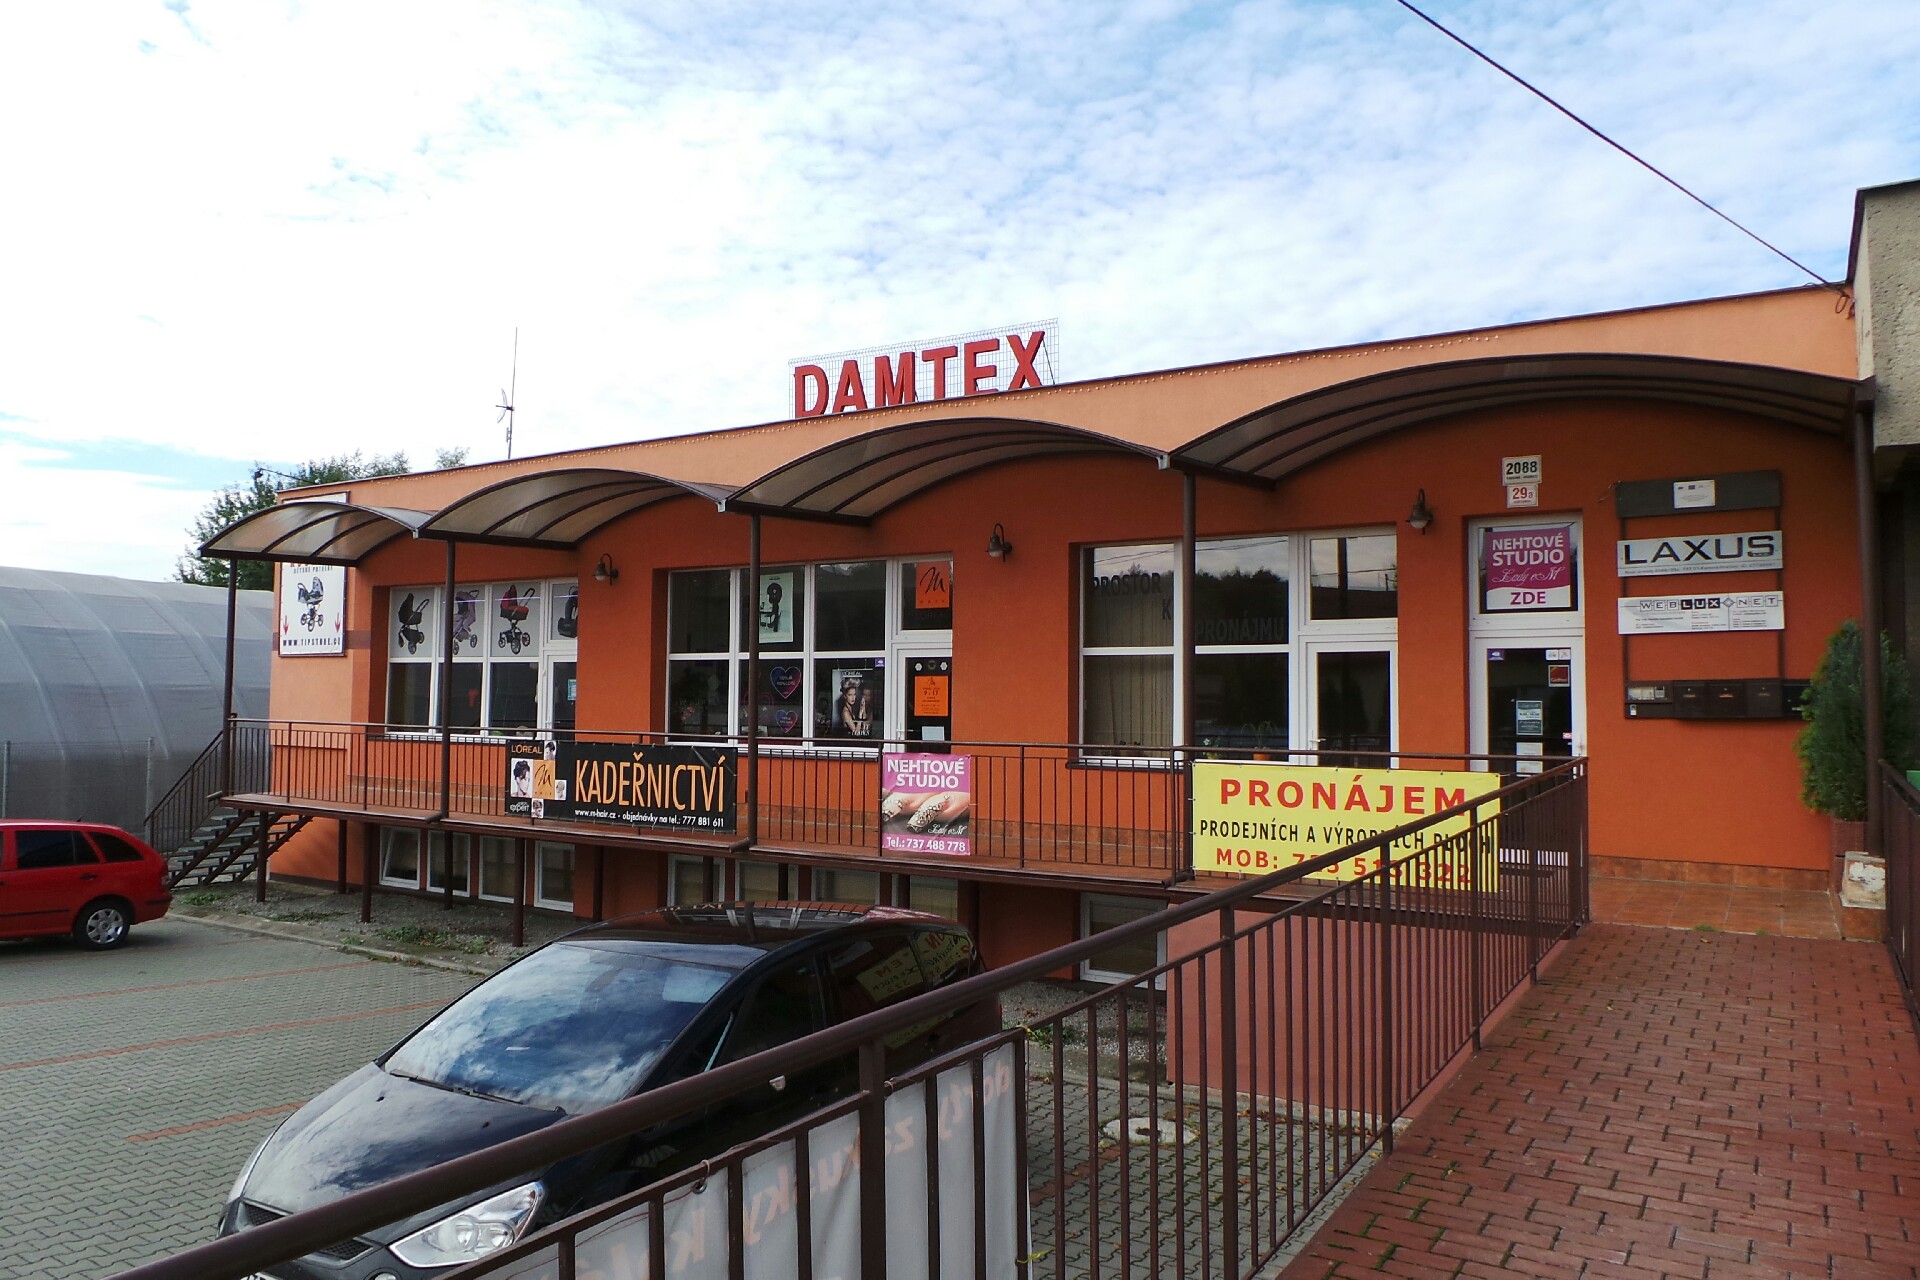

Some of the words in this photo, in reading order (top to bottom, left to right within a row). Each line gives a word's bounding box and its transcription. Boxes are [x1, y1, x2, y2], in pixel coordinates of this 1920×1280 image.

[794, 331, 1045, 418] DAMTEX
[1506, 461, 1538, 475] 2088
[1512, 487, 1533, 500] 29a
[1492, 532, 1564, 551] NEHTOVÉ
[1624, 535, 1775, 565] LAXUS
[1492, 549, 1564, 567] STUDIO
[1093, 573, 1161, 596] PROSTOR
[1492, 567, 1530, 586] Lady
[1510, 591, 1547, 605] ZDE
[1738, 597, 1777, 606] NET
[1162, 598, 1172, 620] K
[1195, 610, 1285, 642] PRONÁJMU
[887, 758, 965, 775] NEHTOVÉ
[575, 751, 726, 813] KADEŘNICTVÍ
[896, 774, 959, 789] STUDIO
[1220, 775, 1466, 817] PRONÁJEM
[622, 810, 658, 825] objednávky
[668, 815, 681, 825] tel.:
[682, 815, 696, 825] 777
[697, 817, 710, 826] 881
[712, 818, 724, 828] 611
[1200, 818, 1298, 843] PRODEJNÍCH
[1306, 826, 1316, 843] A
[887, 836, 905, 848] Tel.:
[907, 838, 925, 849] 737
[926, 839, 945, 850] 488
[947, 841, 966, 852] 778
[1215, 848, 1279, 870] MOB:
